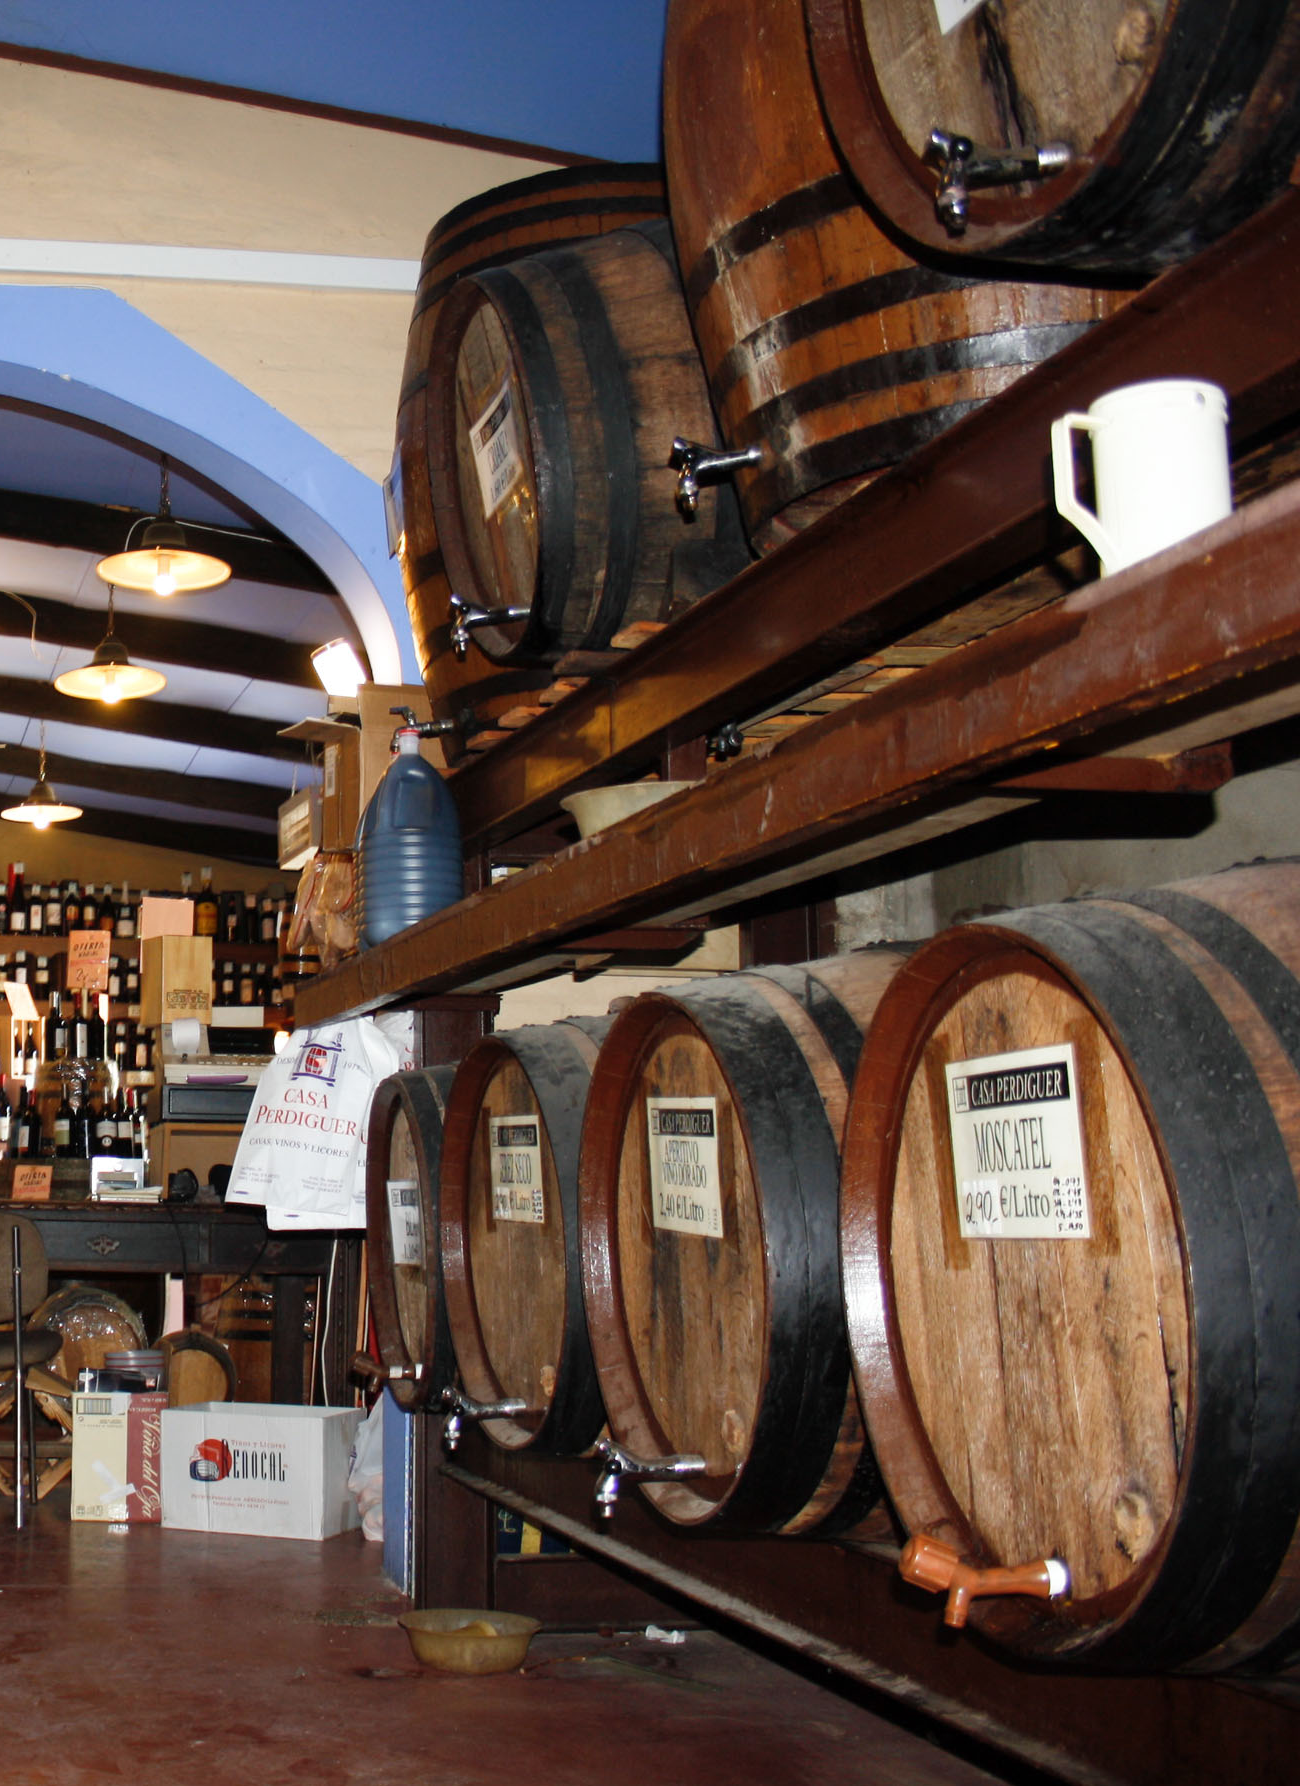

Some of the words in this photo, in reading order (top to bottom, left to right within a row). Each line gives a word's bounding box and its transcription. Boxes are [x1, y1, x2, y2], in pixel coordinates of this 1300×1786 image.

[283, 1087, 329, 1110] CASA
[971, 1080, 995, 1106] CASA
[995, 1069, 1062, 1104] PERDIGUER
[254, 1104, 357, 1137] PERDIGUER
[660, 1113, 676, 1133] CASA
[675, 1112, 711, 1134] PERDIGUER
[274, 1138, 302, 1150] VINOS
[303, 1143, 311, 1151] Y
[310, 1144, 350, 1158] LICORES
[664, 1140, 699, 1165] APERITIVO
[973, 1116, 1052, 1173] MOSCATEL
[662, 1162, 679, 1186] VINO
[679, 1164, 707, 1189] DORADO
[660, 1192, 676, 1219] 2,40
[676, 1195, 704, 1222] €/Litro
[1000, 1184, 1050, 1218] €/Litro
[140, 1413, 161, 1458] Viña
[142, 1458, 159, 1487] del
